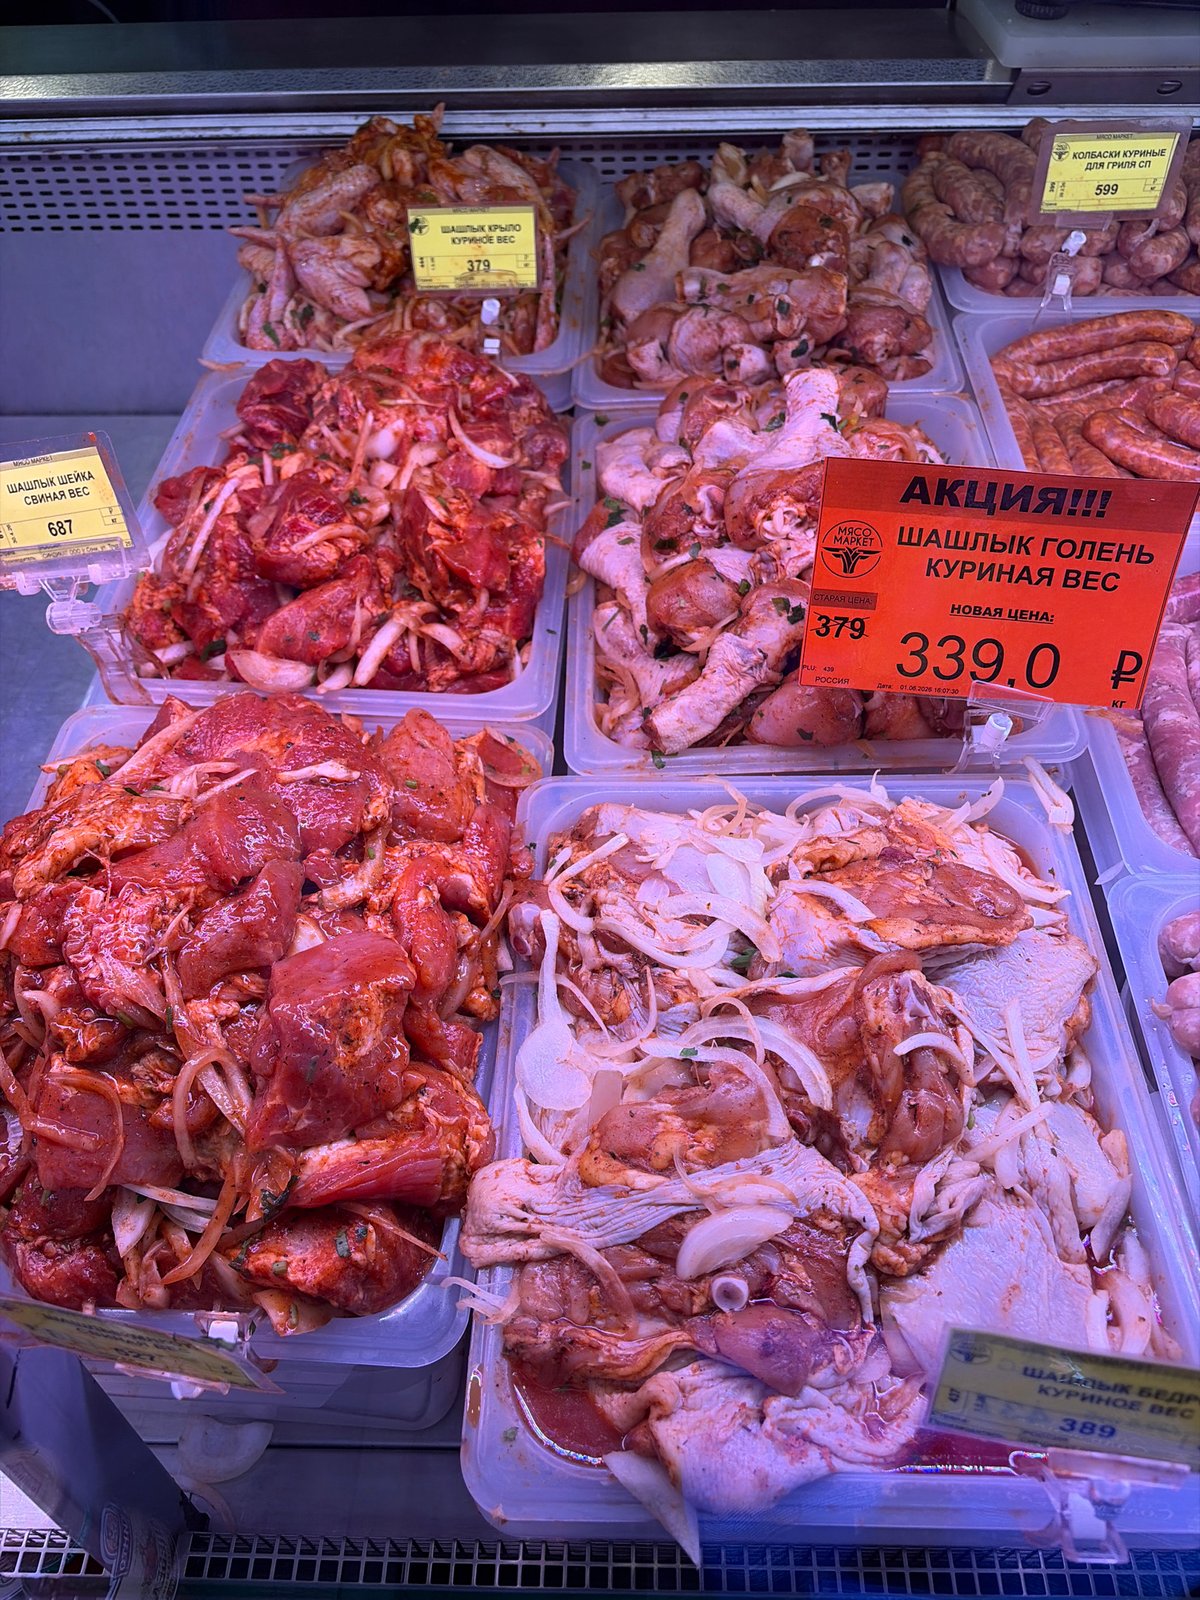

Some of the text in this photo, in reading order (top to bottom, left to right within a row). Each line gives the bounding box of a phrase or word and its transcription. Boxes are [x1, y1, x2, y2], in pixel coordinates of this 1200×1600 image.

[1072, 148, 1167, 160] КОЛБАСКИ КУРИНЫЕ
[1085, 160, 1151, 171] ДЛЯ ГРИЛЯ СП
[1094, 183, 1119, 196] 599
[441, 223, 521, 234] ШАШЛЫК КРЫЛО
[451, 235, 516, 245] КУРИНОЕ ВЕС
[467, 259, 491, 272] 379
[6, 470, 95, 494] ШАШЛЫК ШЕЙКА
[23, 486, 90, 506] СВИНАЯ ВЕС
[899, 475, 1113, 519] АКЦИЯ!!!
[47, 519, 73, 537] 687
[837, 525, 872, 537] МЯСО
[833, 536, 875, 547] МАРКЕТ
[897, 526, 1155, 565] ШАШЛЫК ГОЛЕНЬ
[925, 558, 1121, 592] КУРИНАЯ ВЕС
[813, 593, 873, 605] СТАРАЯ ЦЕНА:
[950, 604, 1055, 623] НОВАЯ ЦЕНА:
[814, 615, 866, 640] 379
[815, 676, 850, 685] РОССИЯ
[1112, 700, 1126, 708] кг
[1037, 1384, 1195, 1420] КУРИНОЕ ВЕС
[1137, 1386, 1200, 1406] БЕДР
[1059, 1417, 1116, 1439] 389
